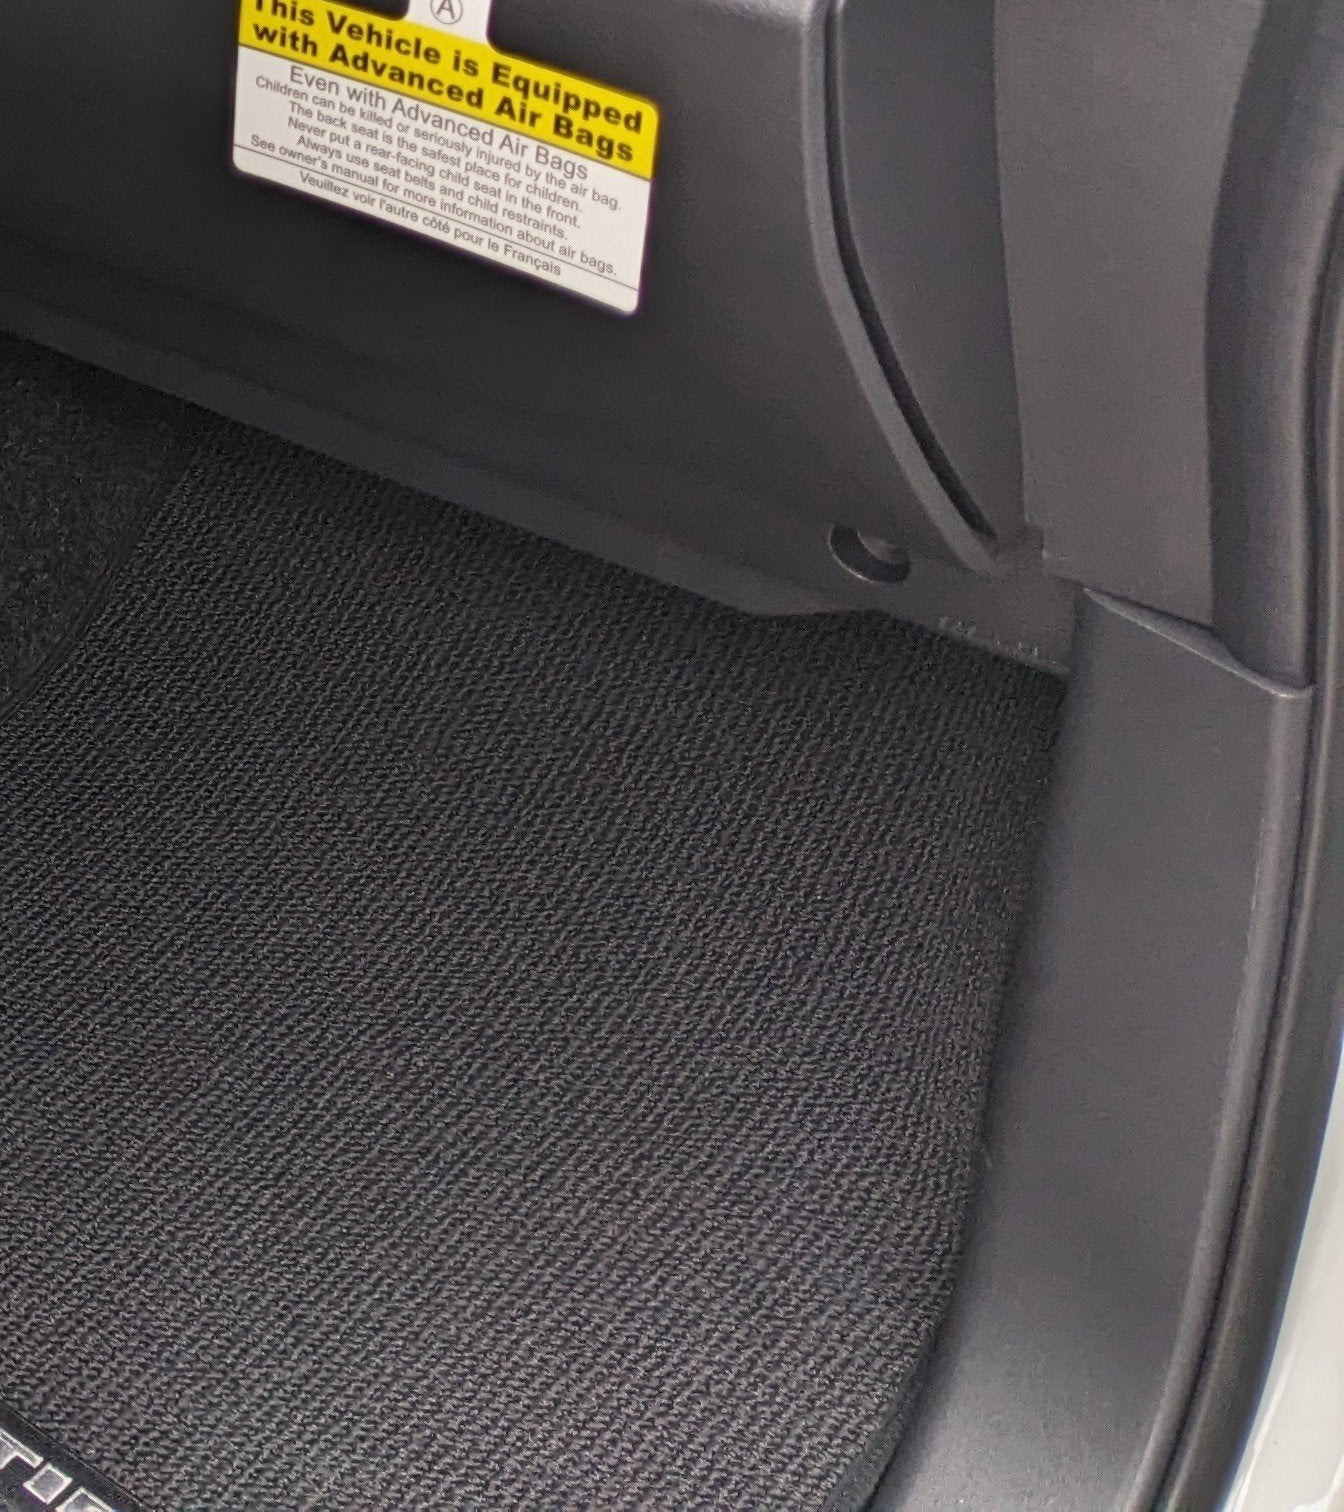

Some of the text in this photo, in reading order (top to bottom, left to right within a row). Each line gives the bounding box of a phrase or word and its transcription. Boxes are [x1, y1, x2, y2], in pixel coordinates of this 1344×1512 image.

[253, 23, 633, 162] with Advanced Air Bags
[289, 65, 588, 180] Even with Advanced Air Bags
[326, 10, 442, 65] Vehicle
[453, 49, 479, 77] is
[492, 61, 642, 134] Equipped
[255, 75, 621, 211] Children can be killed or seriously injured by the air bag.
[288, 116, 581, 229] Never put a rear-facing child seat in the front.
[289, 100, 583, 213] The back seat is the safest place for children.
[297, 134, 568, 240] Always use seat belts and child restraints.
[251, 135, 617, 276] See owner's manual for more information about air bags.
[300, 170, 561, 276] Veuillez voir l'autre côté pour le Français
